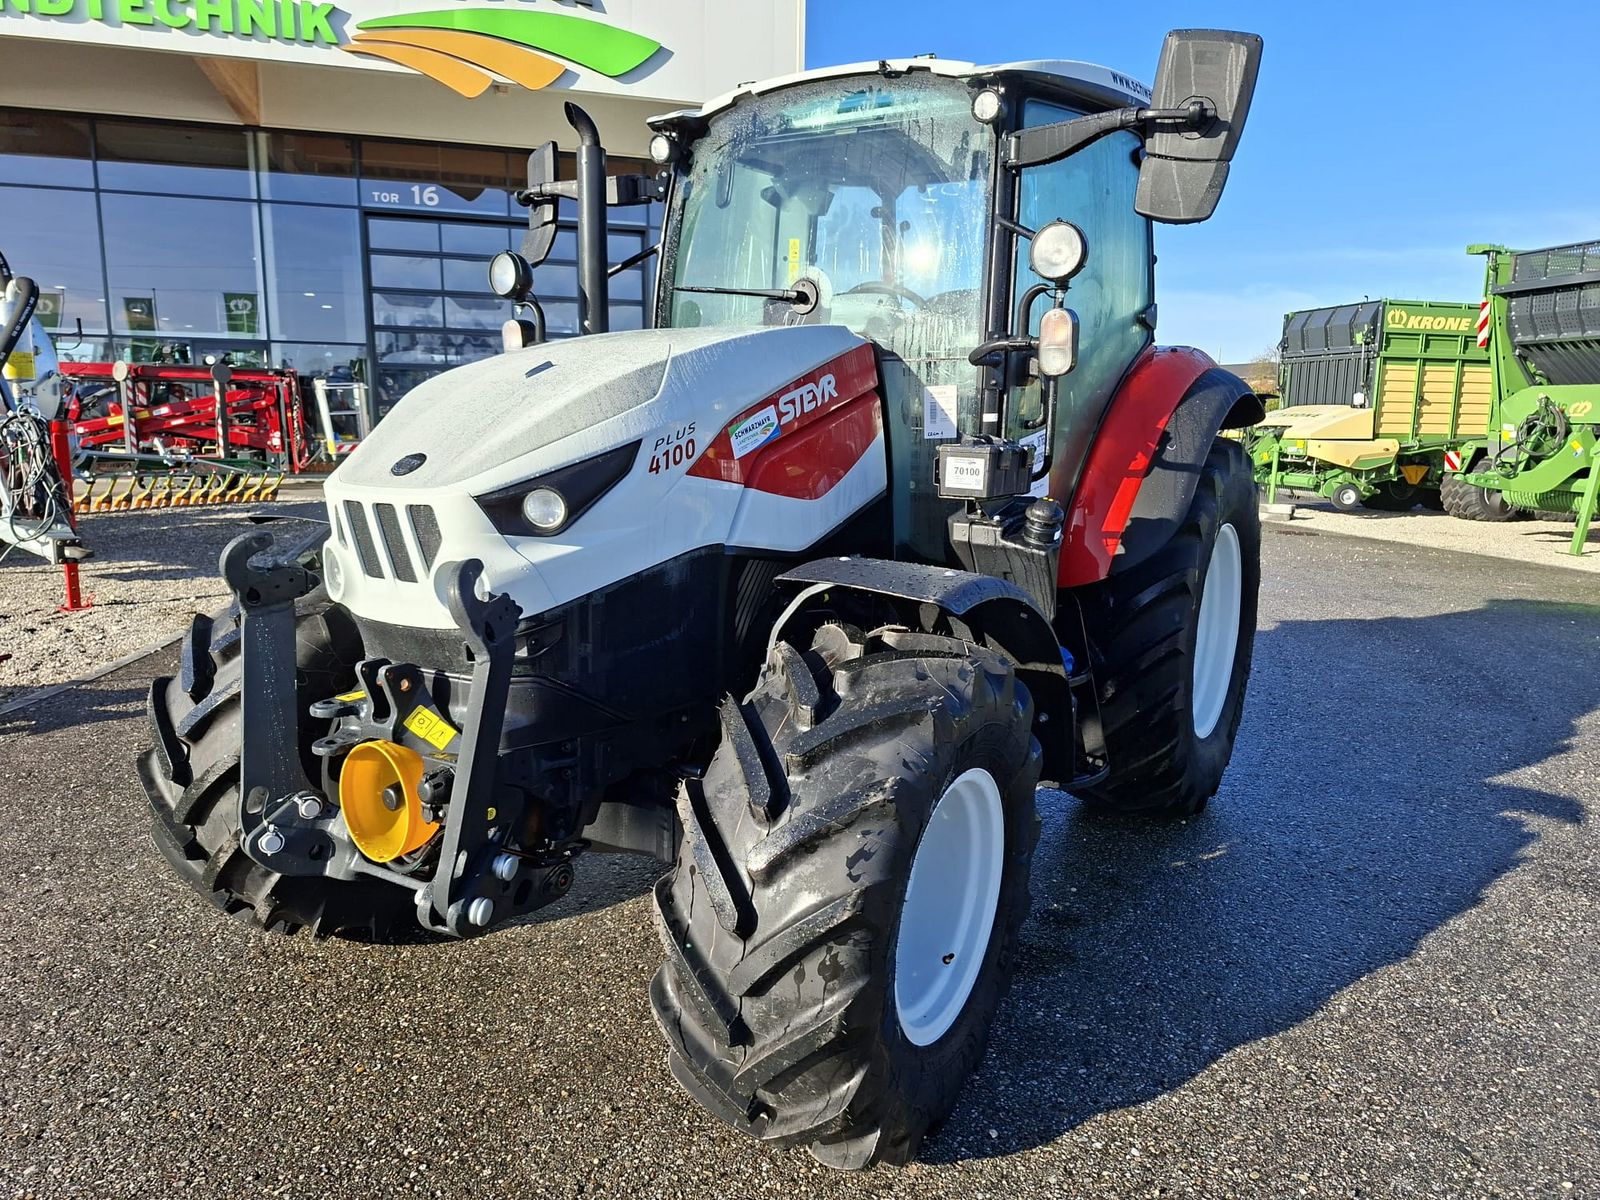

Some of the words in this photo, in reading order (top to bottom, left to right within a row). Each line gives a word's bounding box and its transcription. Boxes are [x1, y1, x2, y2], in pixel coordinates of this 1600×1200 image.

[372, 191, 399, 203] TOR
[411, 185, 439, 206] 16
[1406, 315, 1472, 331] KRONE
[779, 373, 838, 425] STEYR
[654, 421, 696, 452] PLUS
[734, 415, 771, 440] SCHWARZMAYR
[648, 438, 696, 475] 4100
[953, 466, 980, 477] 70100
